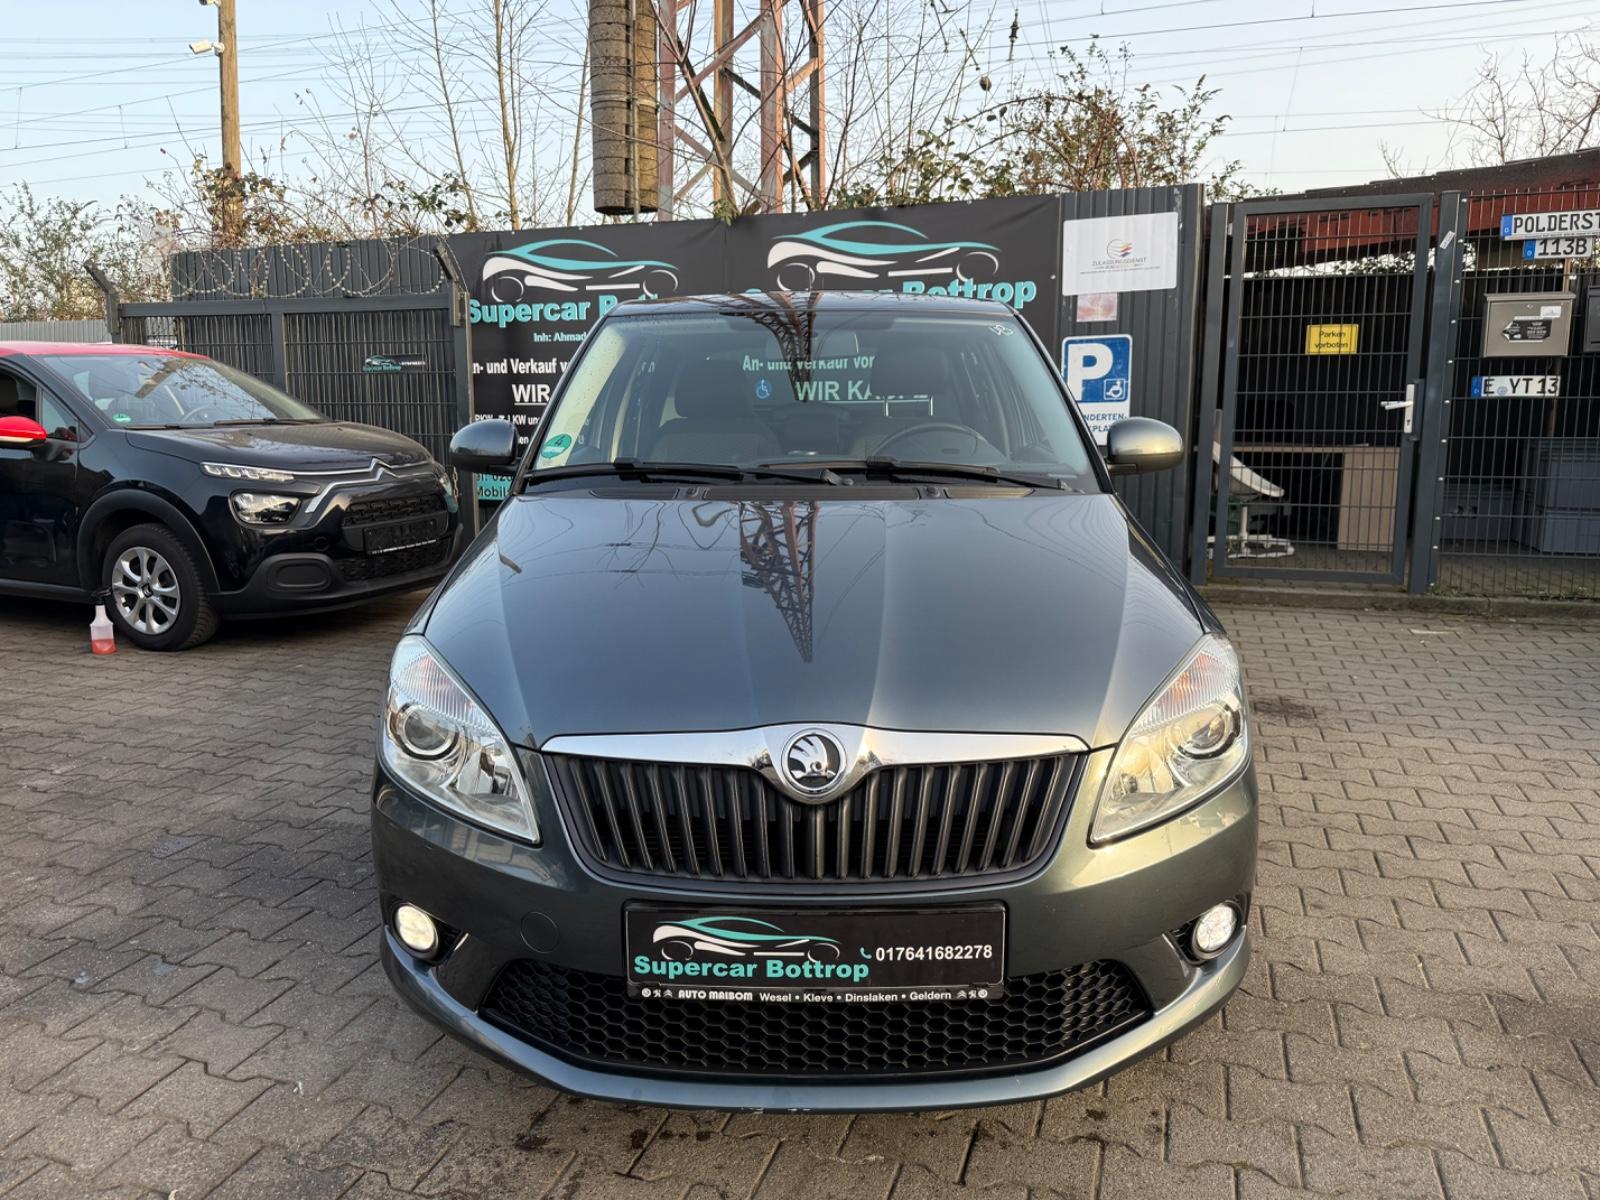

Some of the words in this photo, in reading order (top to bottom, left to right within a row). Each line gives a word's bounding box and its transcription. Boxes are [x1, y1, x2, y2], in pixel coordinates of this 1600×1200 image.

[1538, 239, 1588, 256] 113B
[469, 298, 591, 328] Supercar
[533, 332, 552, 342] Inh:
[472, 362, 484, 374] n-
[486, 359, 508, 374] und
[510, 357, 558, 374] Verkauf
[742, 355, 764, 371] An-
[1067, 343, 1114, 400] P
[512, 384, 551, 403] WIR
[796, 381, 840, 400] WIR
[1509, 378, 1533, 394] YT
[875, 945, 993, 961] 017641682278
[634, 955, 758, 980] Supercar
[766, 959, 870, 982] Bottrop
[678, 989, 707, 1000] AUTO
[759, 992, 792, 1002] Wesel
[803, 993, 833, 1003] Kleve
[845, 992, 898, 1002] Dinslaken
[909, 991, 951, 1000] Geldern
